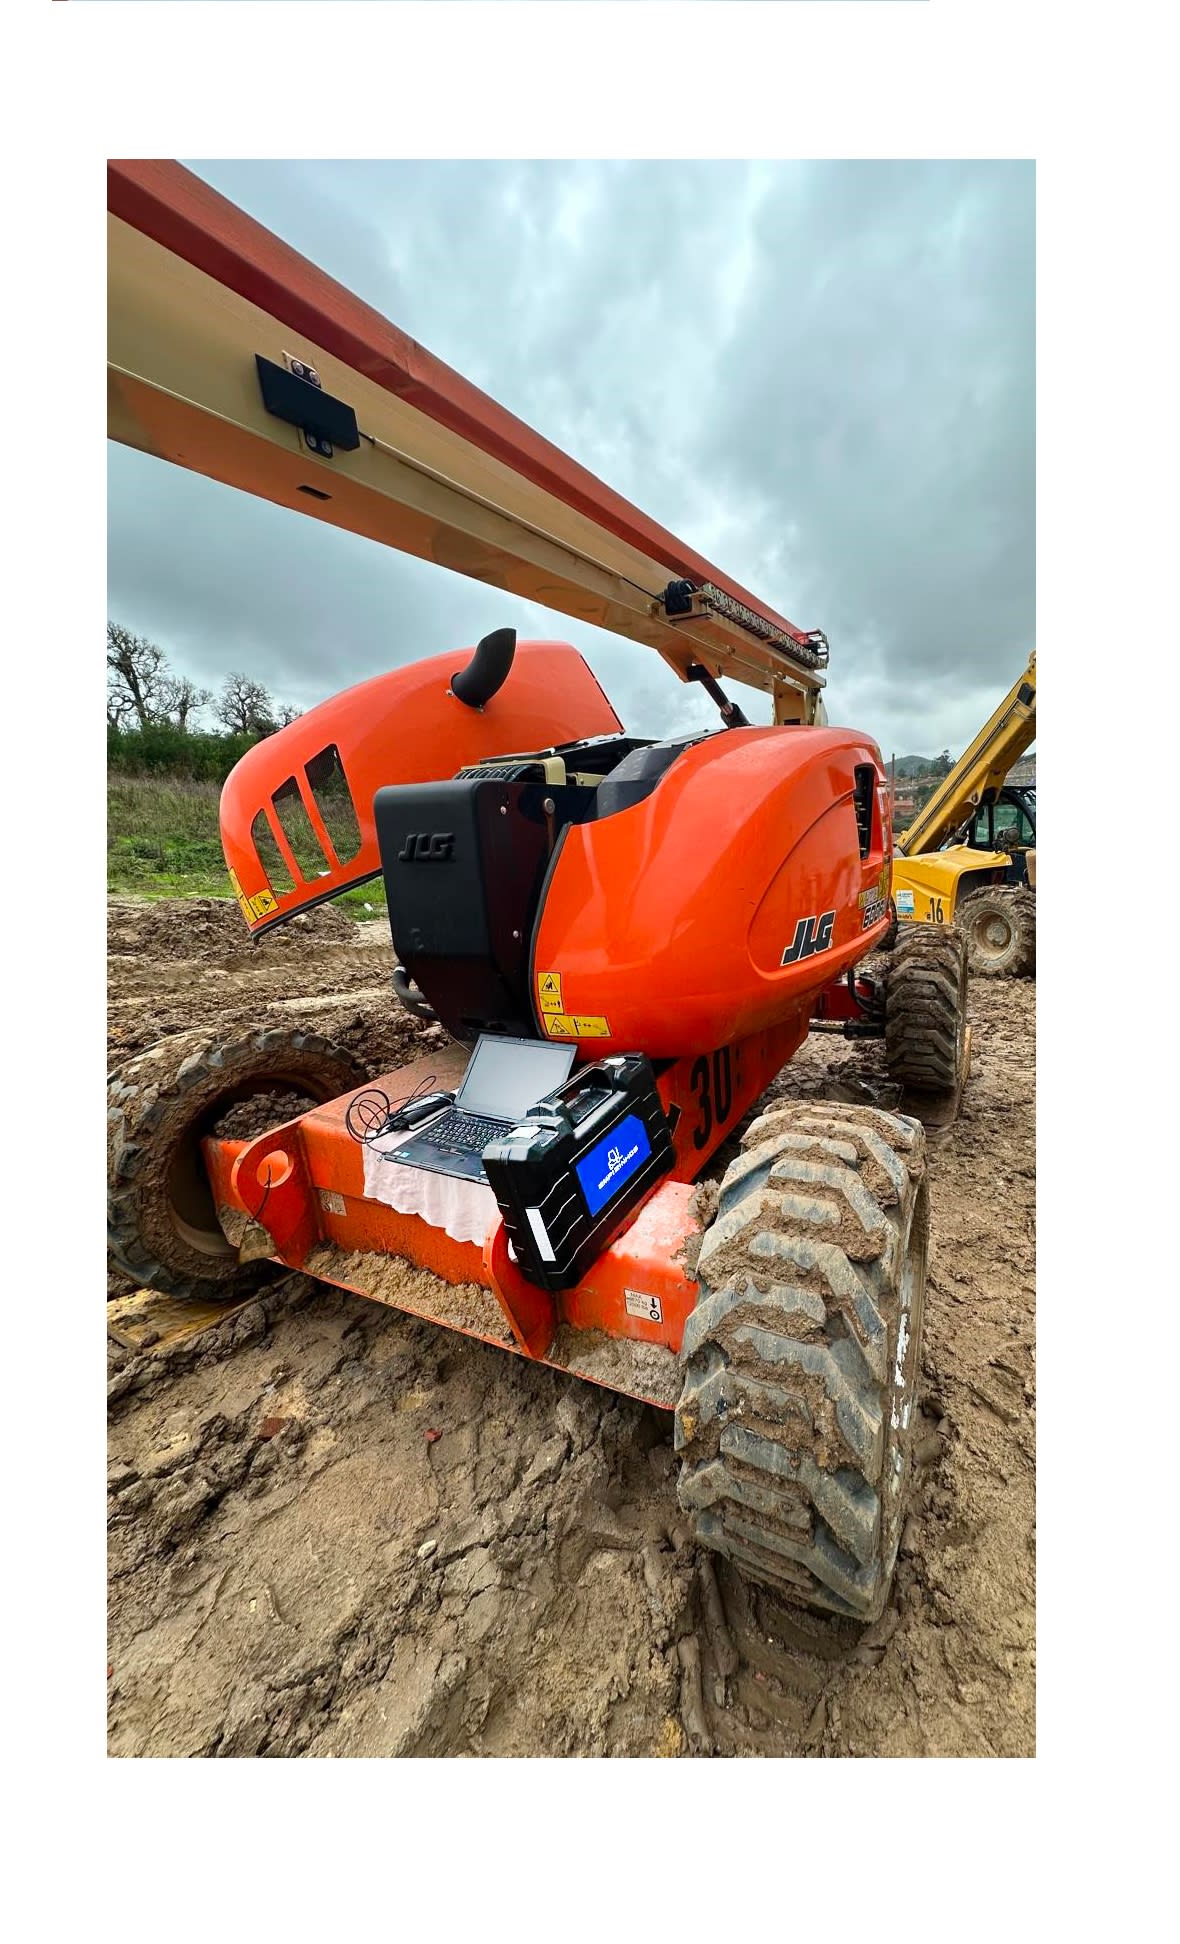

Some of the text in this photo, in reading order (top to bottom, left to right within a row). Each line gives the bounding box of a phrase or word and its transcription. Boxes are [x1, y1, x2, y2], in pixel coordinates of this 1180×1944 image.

[398, 832, 455, 862] JLG
[929, 897, 943, 923] 16
[780, 910, 836, 966] JLG
